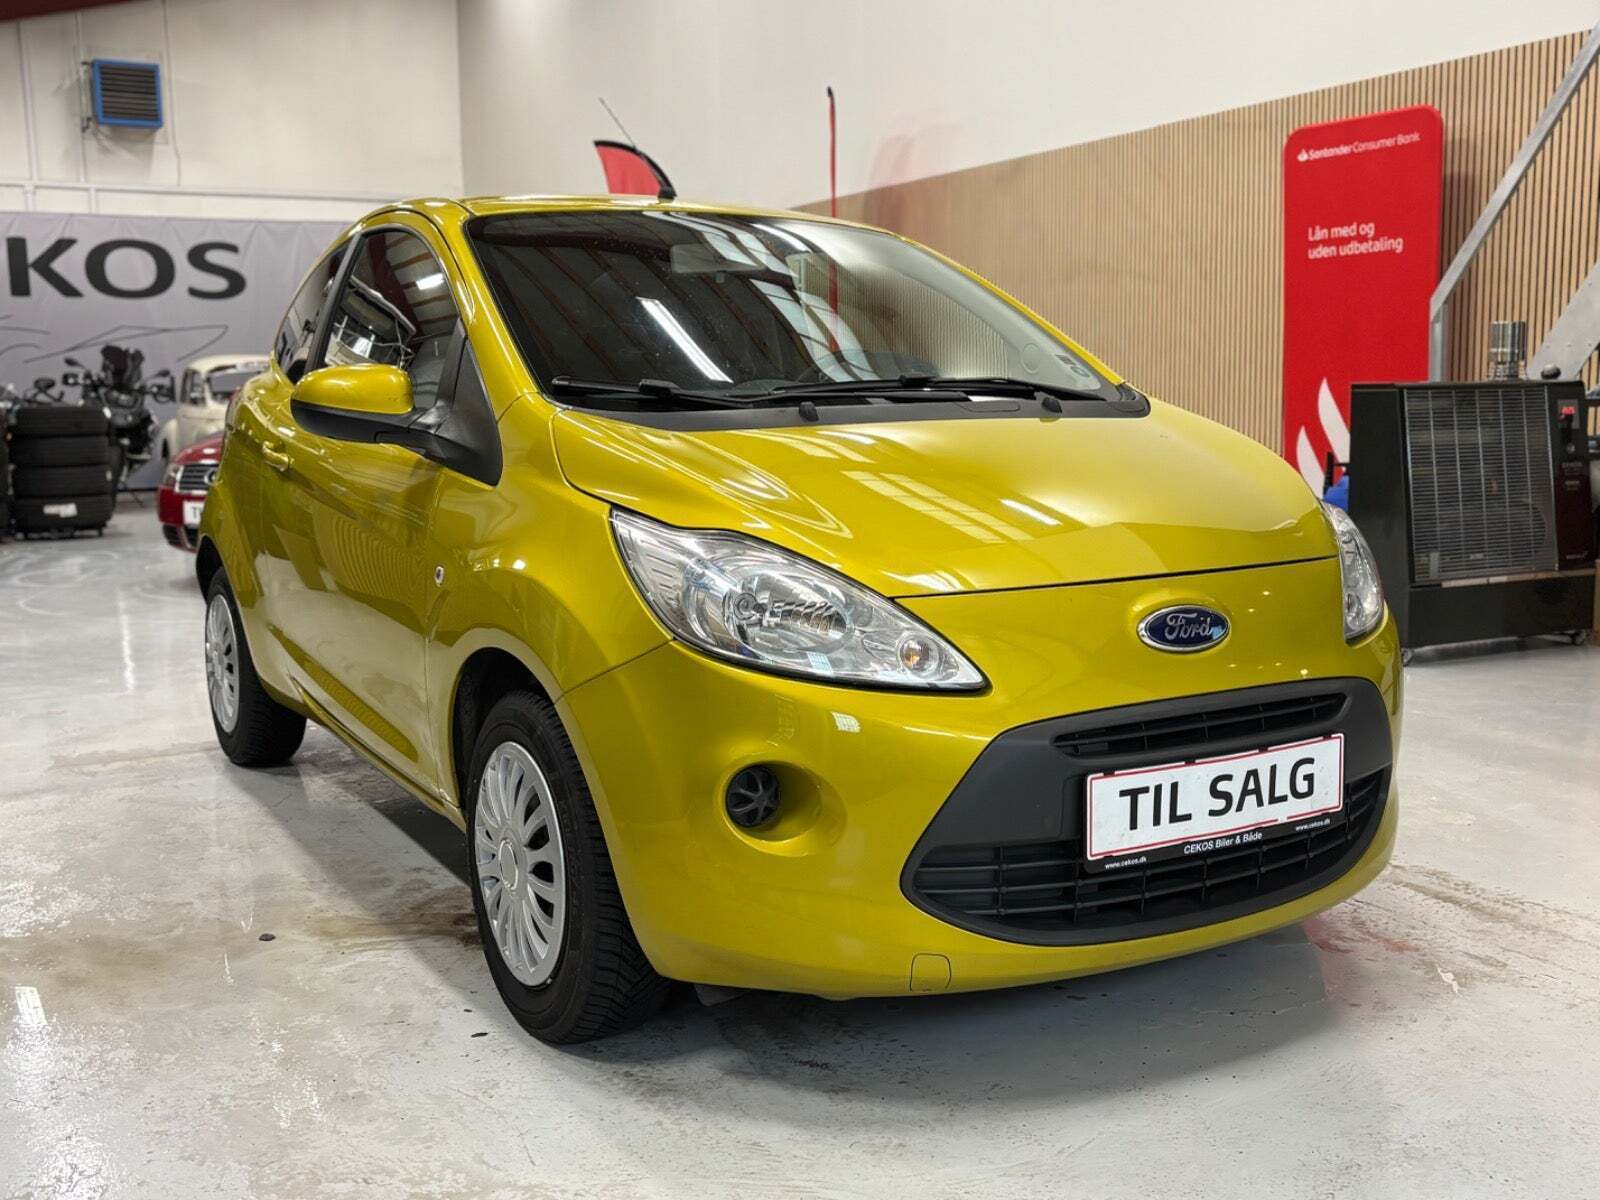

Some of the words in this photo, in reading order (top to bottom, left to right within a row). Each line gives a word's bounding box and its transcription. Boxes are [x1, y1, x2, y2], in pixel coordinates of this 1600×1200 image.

[1397, 132, 1420, 146] Bank
[1308, 225, 1328, 241] Lån
[1331, 222, 1357, 239] med
[1359, 223, 1375, 239] og
[1308, 243, 1337, 260] uden
[1339, 237, 1403, 256] udbetaling
[6, 236, 246, 300] KOS
[1164, 612, 1213, 641] Ford
[1119, 781, 1192, 831] TIL
[1208, 757, 1315, 818] SALG
[1184, 840, 1213, 855] CEKOS
[1215, 837, 1232, 849] Biler
[1235, 836, 1241, 844] &
[1243, 832, 1263, 844] Både
